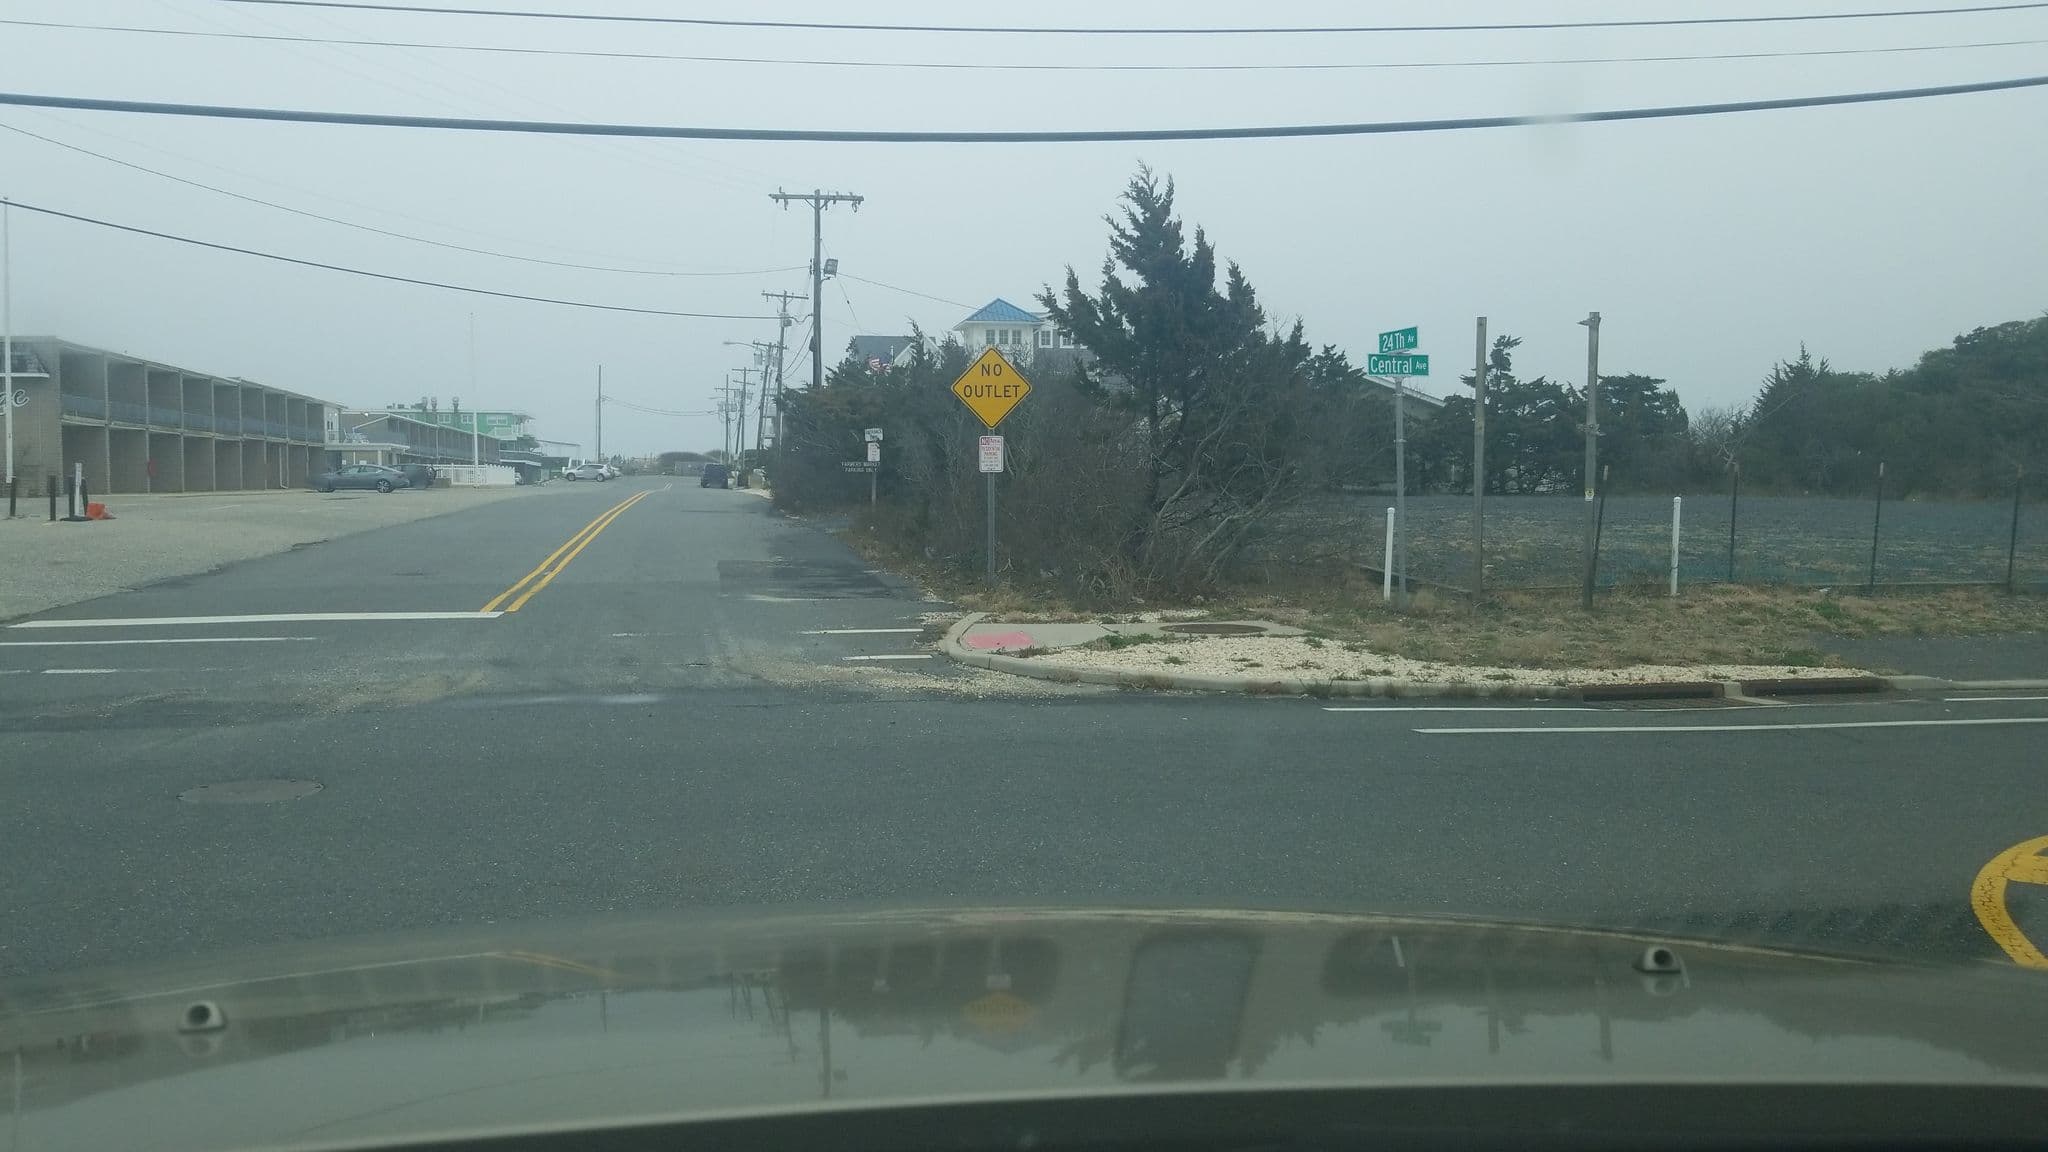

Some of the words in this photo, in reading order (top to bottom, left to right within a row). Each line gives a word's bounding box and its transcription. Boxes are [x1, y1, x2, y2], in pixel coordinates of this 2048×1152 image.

[981, 363, 1002, 377] NO
[1370, 356, 1412, 374] Central
[1415, 361, 1427, 370] Ave
[963, 384, 1020, 398] OUTLET
